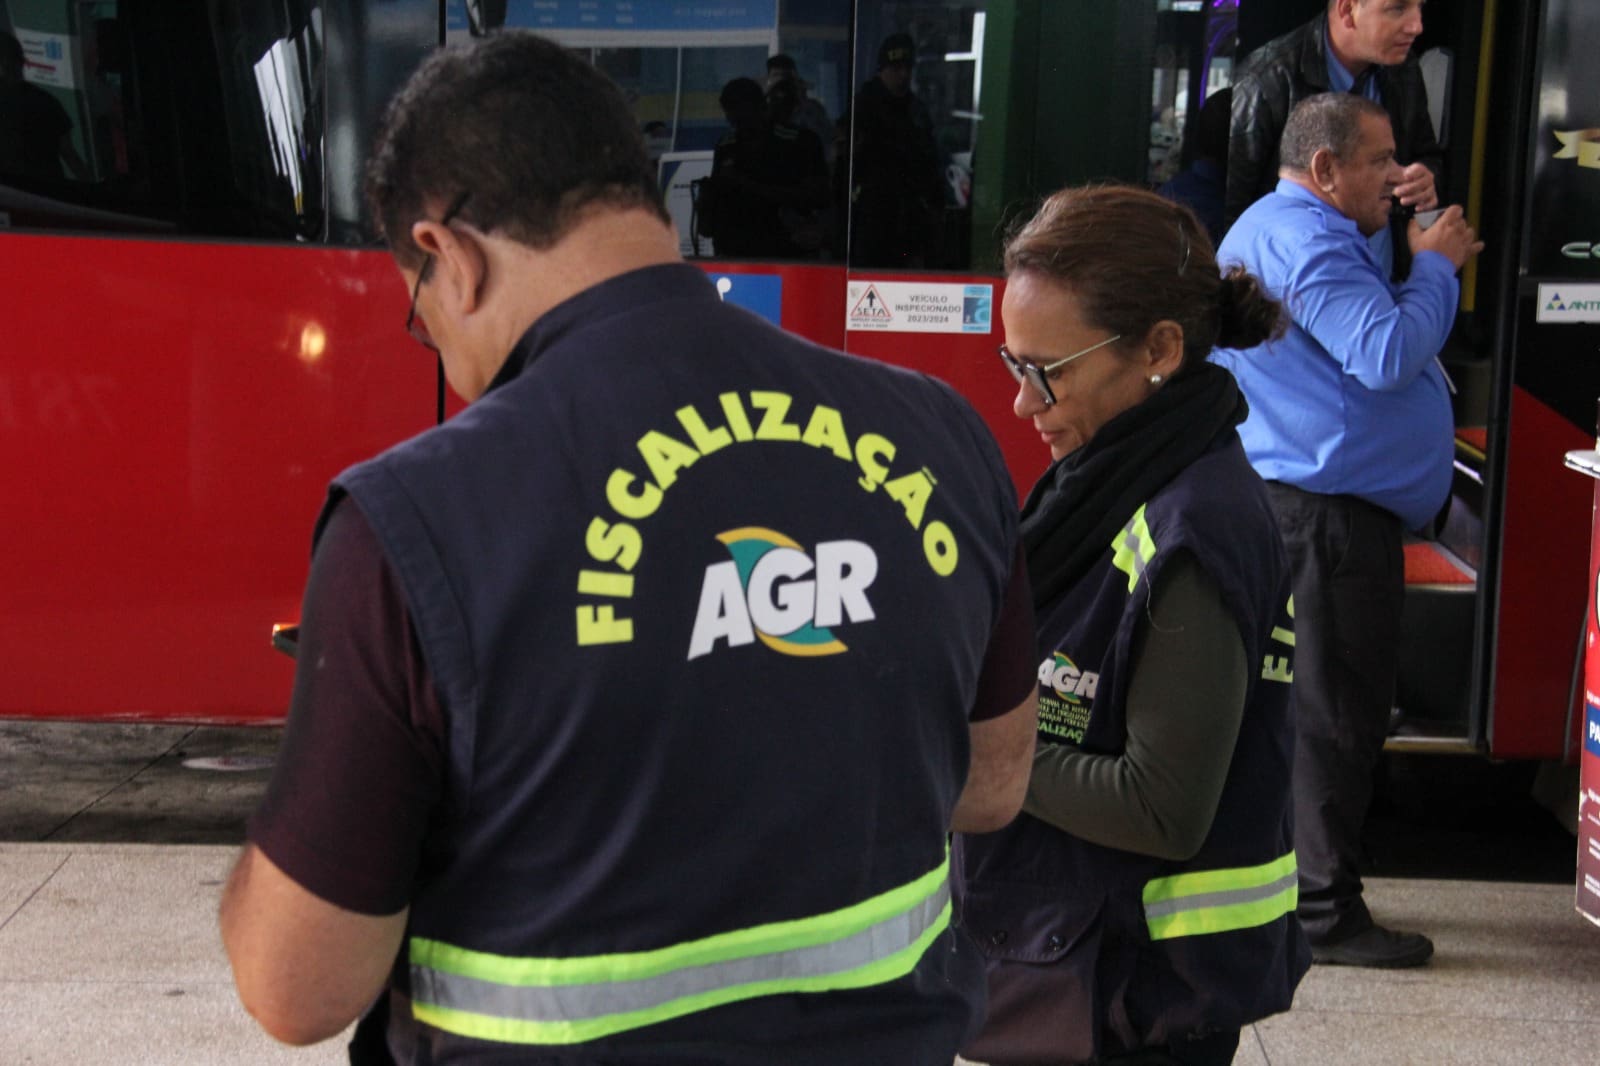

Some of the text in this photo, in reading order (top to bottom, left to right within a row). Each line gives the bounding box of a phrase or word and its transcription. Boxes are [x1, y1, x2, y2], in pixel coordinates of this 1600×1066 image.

[1561, 242, 1600, 259] C
[909, 294, 948, 304] VEÍCULO
[856, 307, 886, 317] SETA
[895, 304, 962, 314] INSPECIONADO
[907, 315, 949, 324] 2023/2024
[576, 390, 958, 646] FISCALIZAÇÃO
[687, 539, 878, 661] AGR
[1038, 721, 1083, 744] ALIZAÇ
